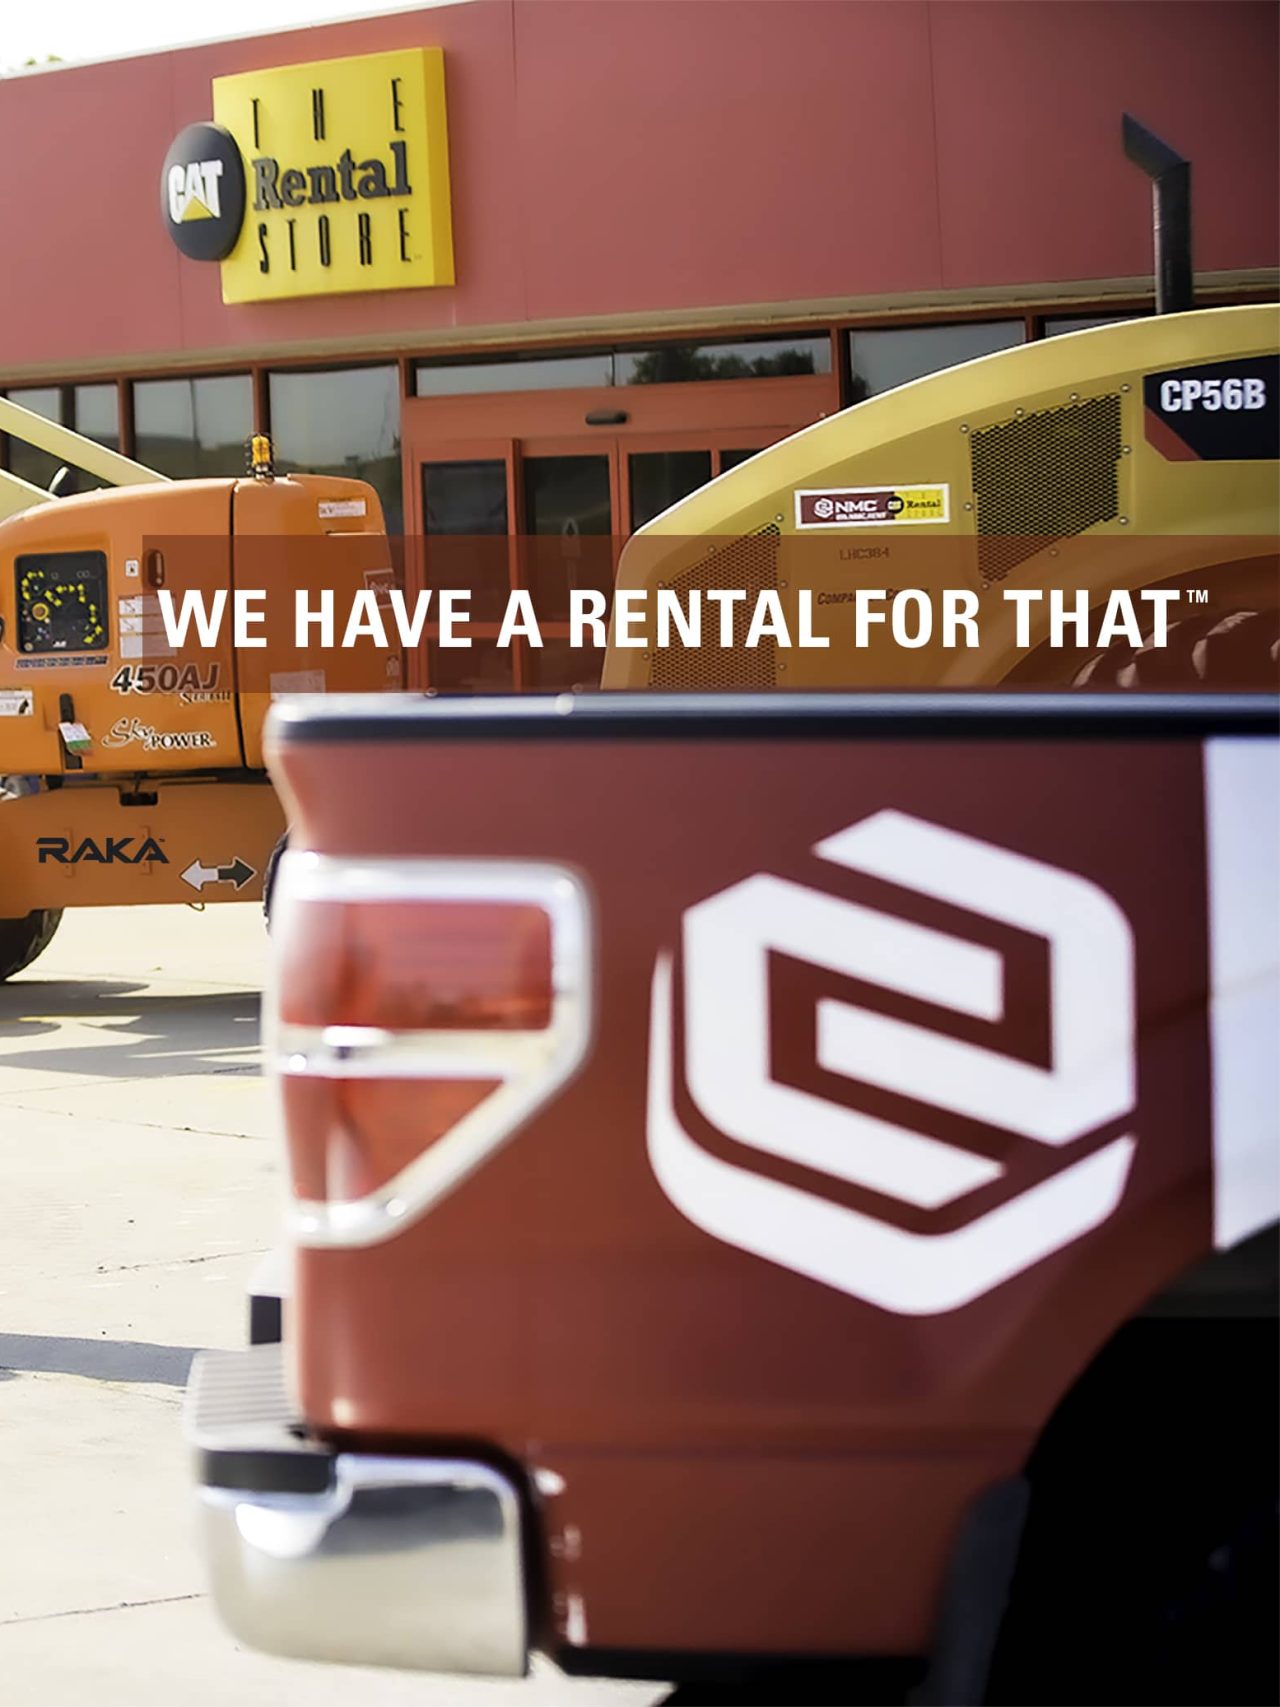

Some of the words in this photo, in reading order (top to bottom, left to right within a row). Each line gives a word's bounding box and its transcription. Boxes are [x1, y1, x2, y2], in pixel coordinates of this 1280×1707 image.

[251, 78, 405, 149] THE
[168, 160, 224, 224] CAT
[251, 140, 412, 211] Rental
[258, 208, 412, 274] STORE
[1160, 378, 1267, 412] CP56B
[835, 499, 879, 513] NMC
[110, 663, 219, 693] 450AJ
[150, 732, 213, 749] POWER
[35, 837, 170, 864] RAKA
